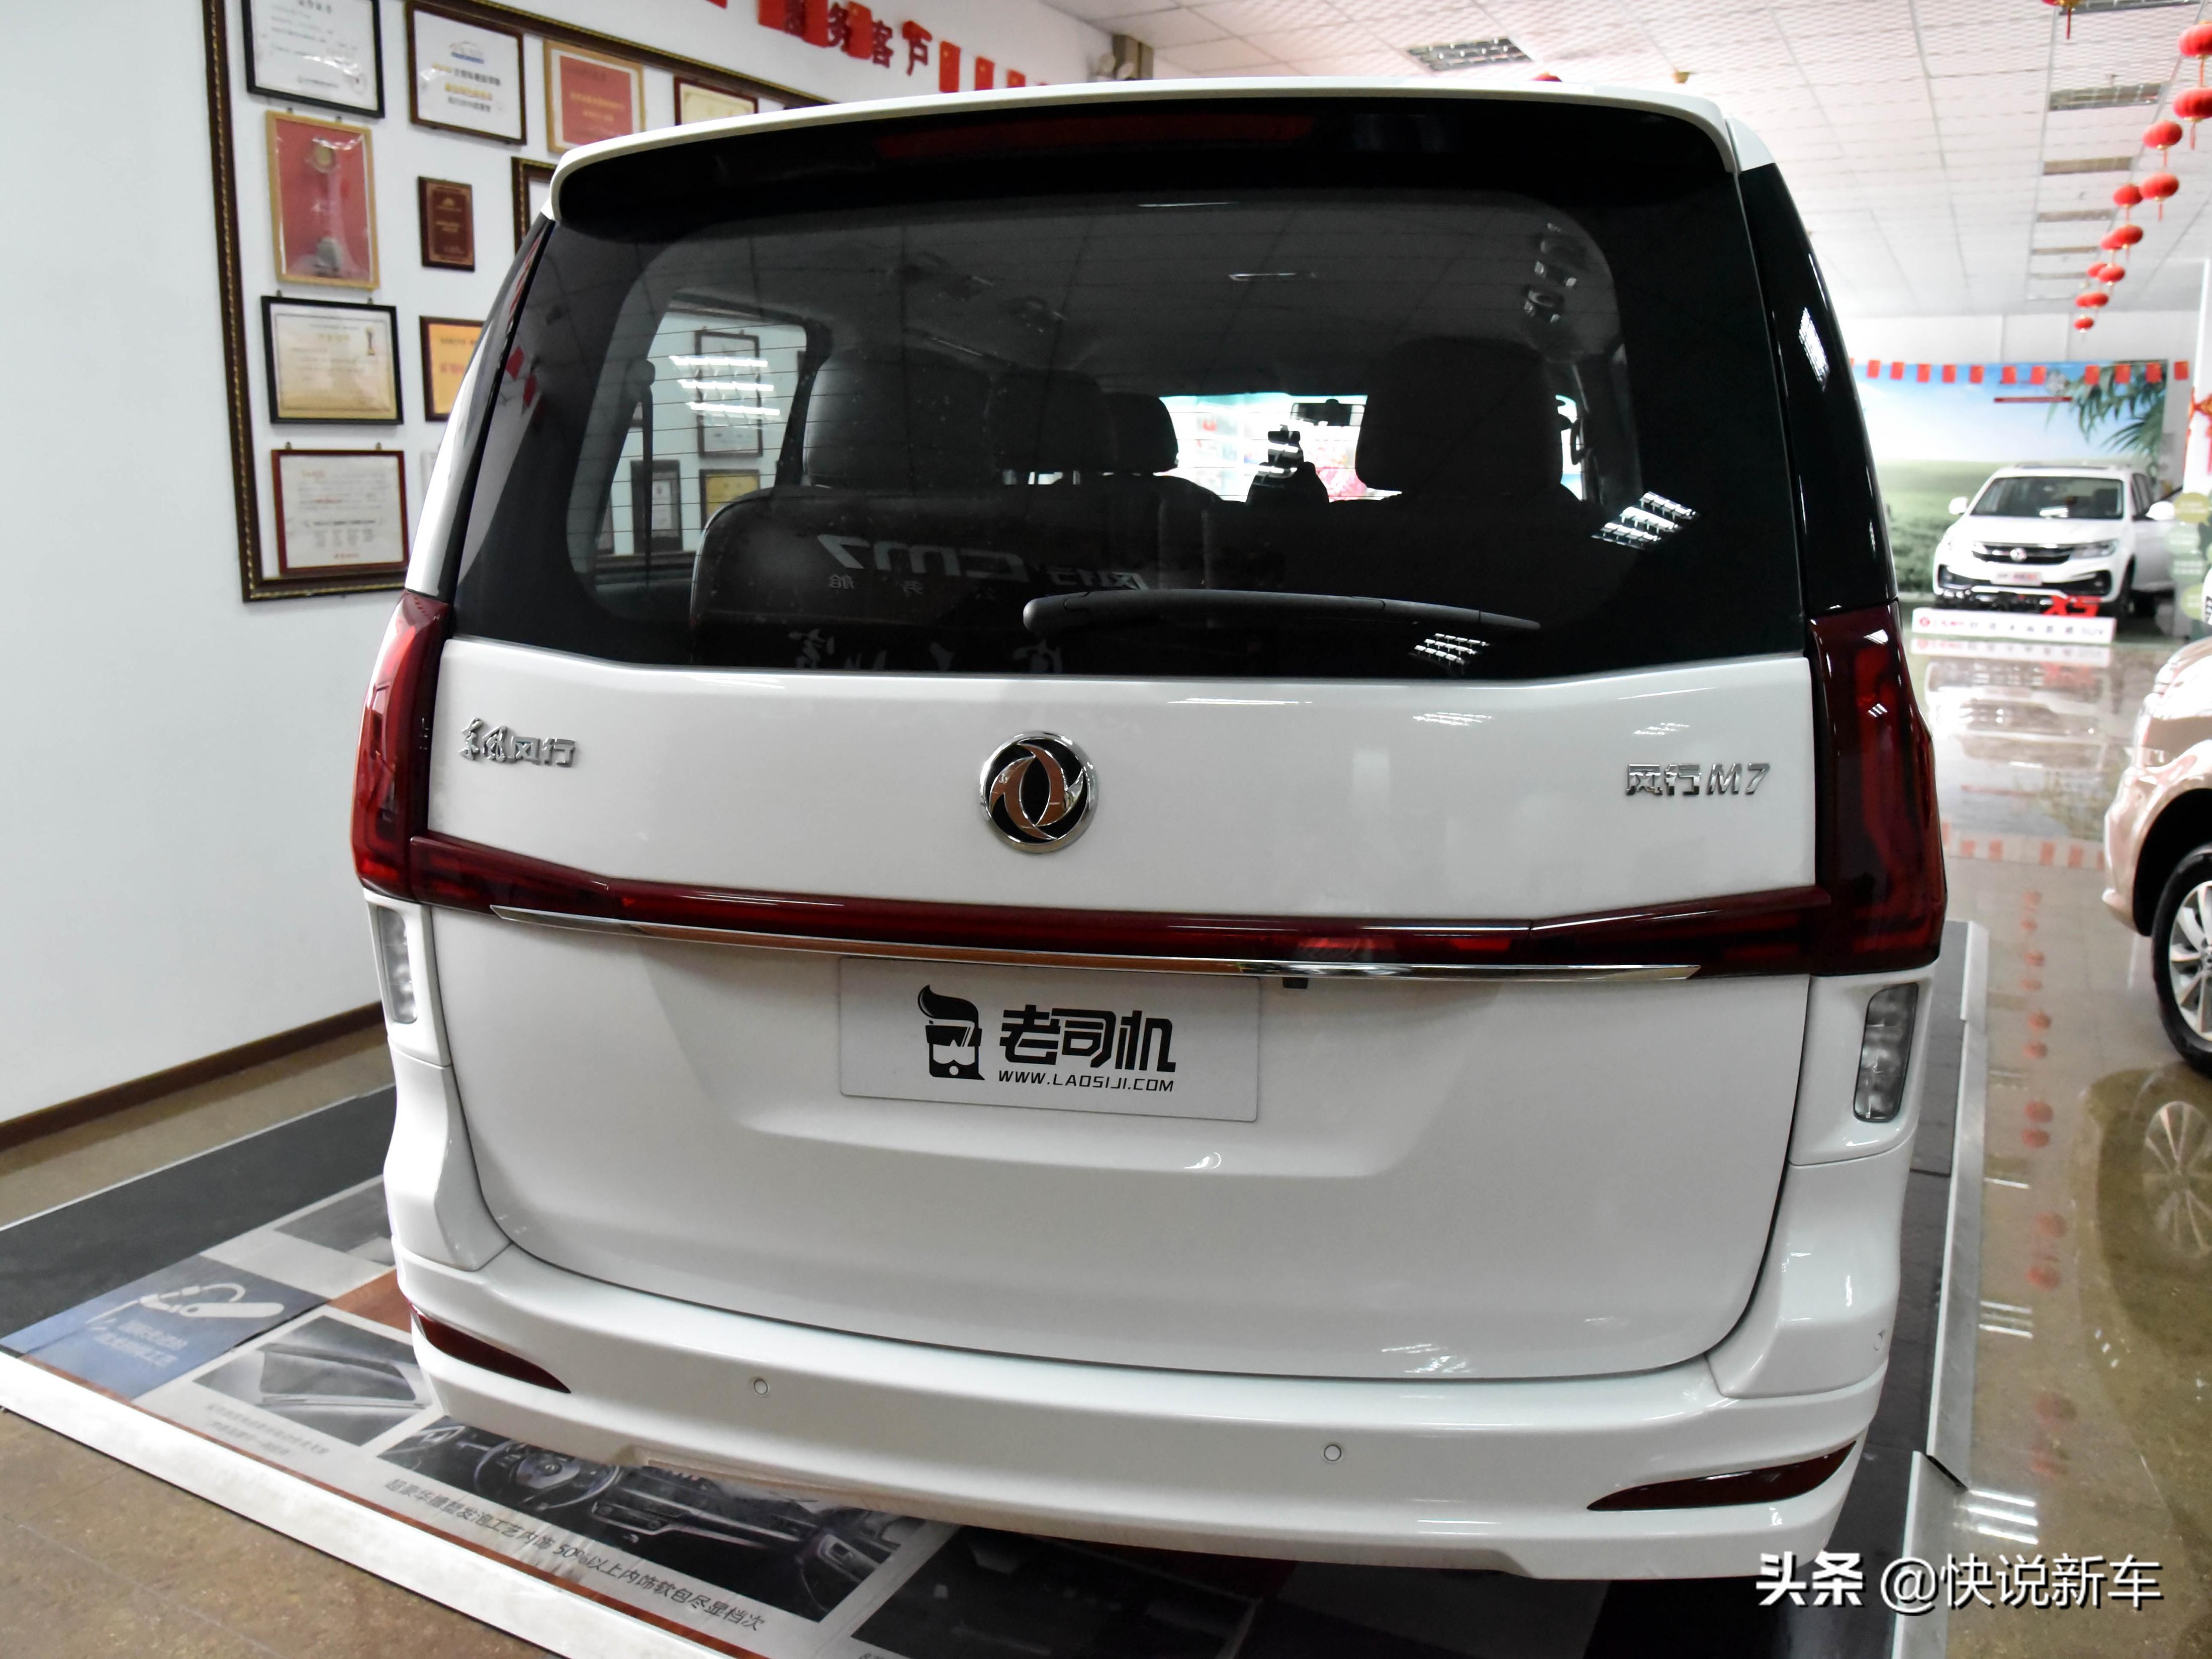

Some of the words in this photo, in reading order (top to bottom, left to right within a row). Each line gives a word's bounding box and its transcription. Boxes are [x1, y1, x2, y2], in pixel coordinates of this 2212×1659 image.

[999, 1004, 1176, 1072] 老司机
[998, 1070, 1174, 1092] WWW.LAOSIJI.COM
